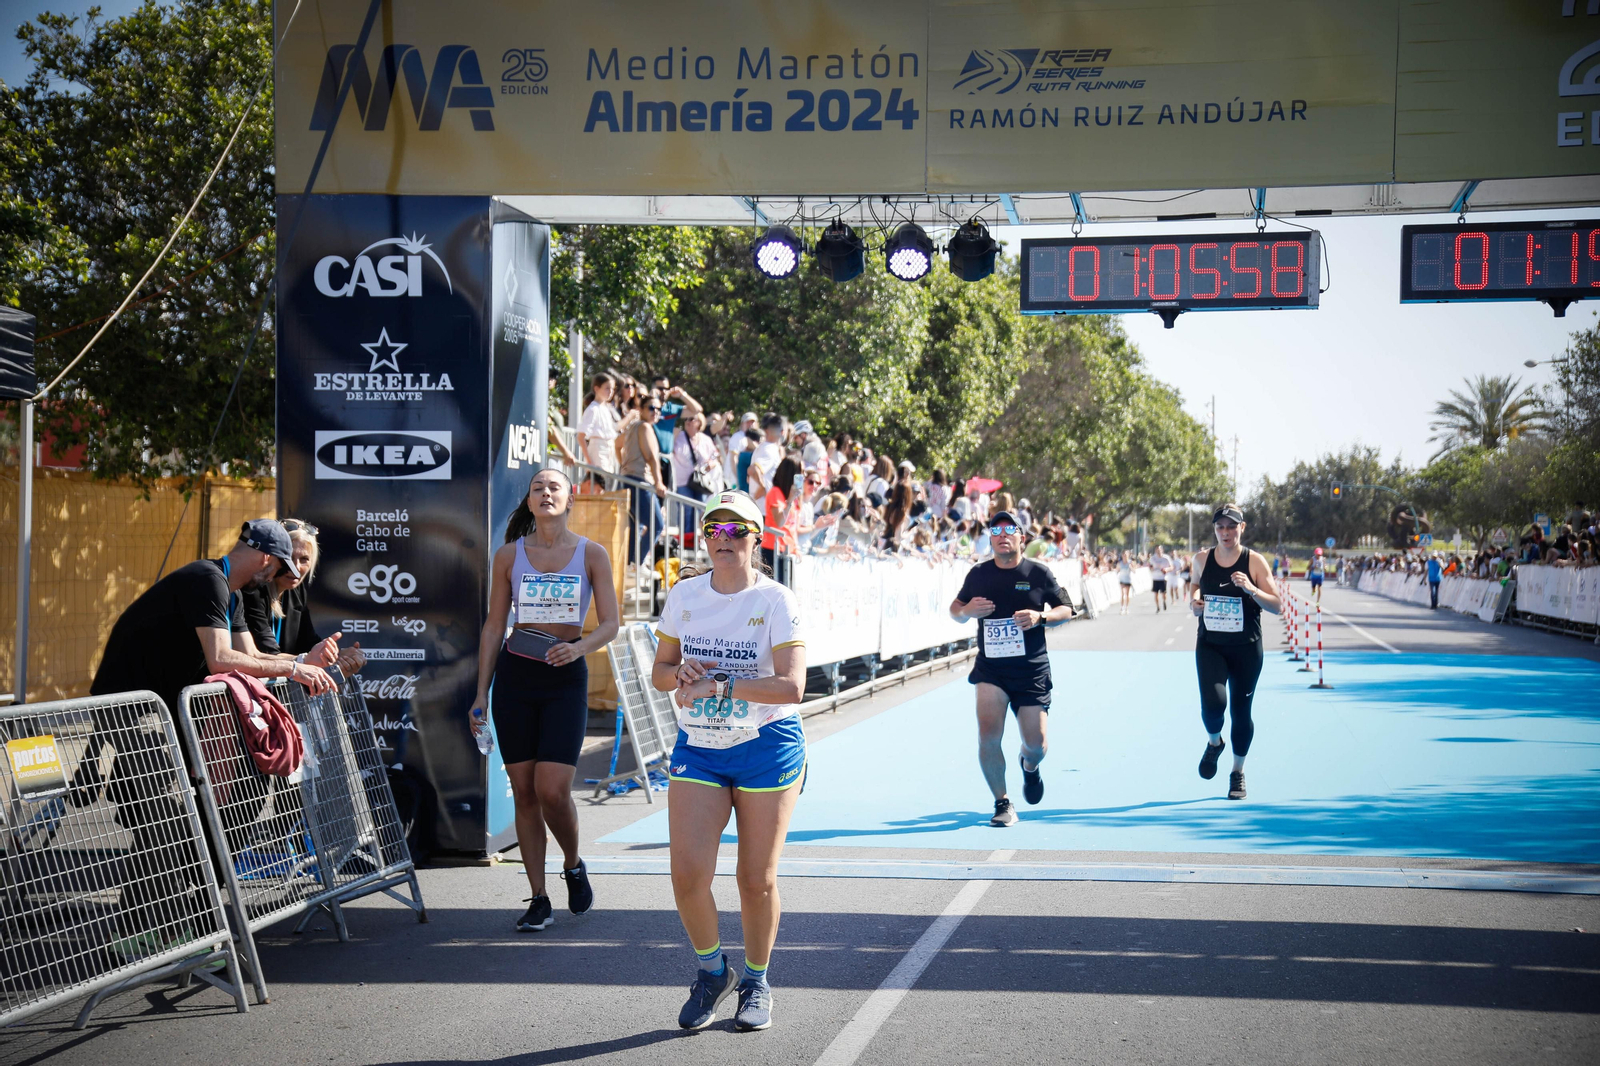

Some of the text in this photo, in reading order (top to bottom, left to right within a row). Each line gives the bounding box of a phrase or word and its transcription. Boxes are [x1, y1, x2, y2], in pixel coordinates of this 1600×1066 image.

[502, 48, 549, 82] 25
[587, 43, 921, 82] Medio Maratón
[1040, 48, 1113, 67] RFEA
[1032, 66, 1105, 80] SERIES
[501, 83, 549, 95] EDICIÓN
[1026, 79, 1147, 93] RUTA RUNNING
[583, 80, 921, 132] Almería 2024
[949, 97, 1309, 130] RAMÓN RUIZ ANDÚJAR
[313, 255, 423, 297] CASI
[503, 327, 519, 345] 2005
[313, 373, 455, 391] ESTRELLA
[346, 391, 423, 401] DE LEVANTE
[333, 445, 437, 465] IKEA
[356, 508, 409, 522] Barceló
[356, 523, 411, 537] Cabo de
[356, 538, 388, 551] Gata
[347, 564, 417, 604] ego
[525, 582, 575, 599] 5762
[391, 596, 420, 604] sport center
[1208, 601, 1240, 614] 5455
[341, 619, 379, 633] SER
[987, 625, 1019, 638] 5915
[683, 634, 758, 649] Medio Maratón
[373, 650, 385, 659] de
[682, 644, 758, 660] Almería 2024
[724, 660, 758, 668] ANDÚJAR
[688, 697, 749, 719] 5693
